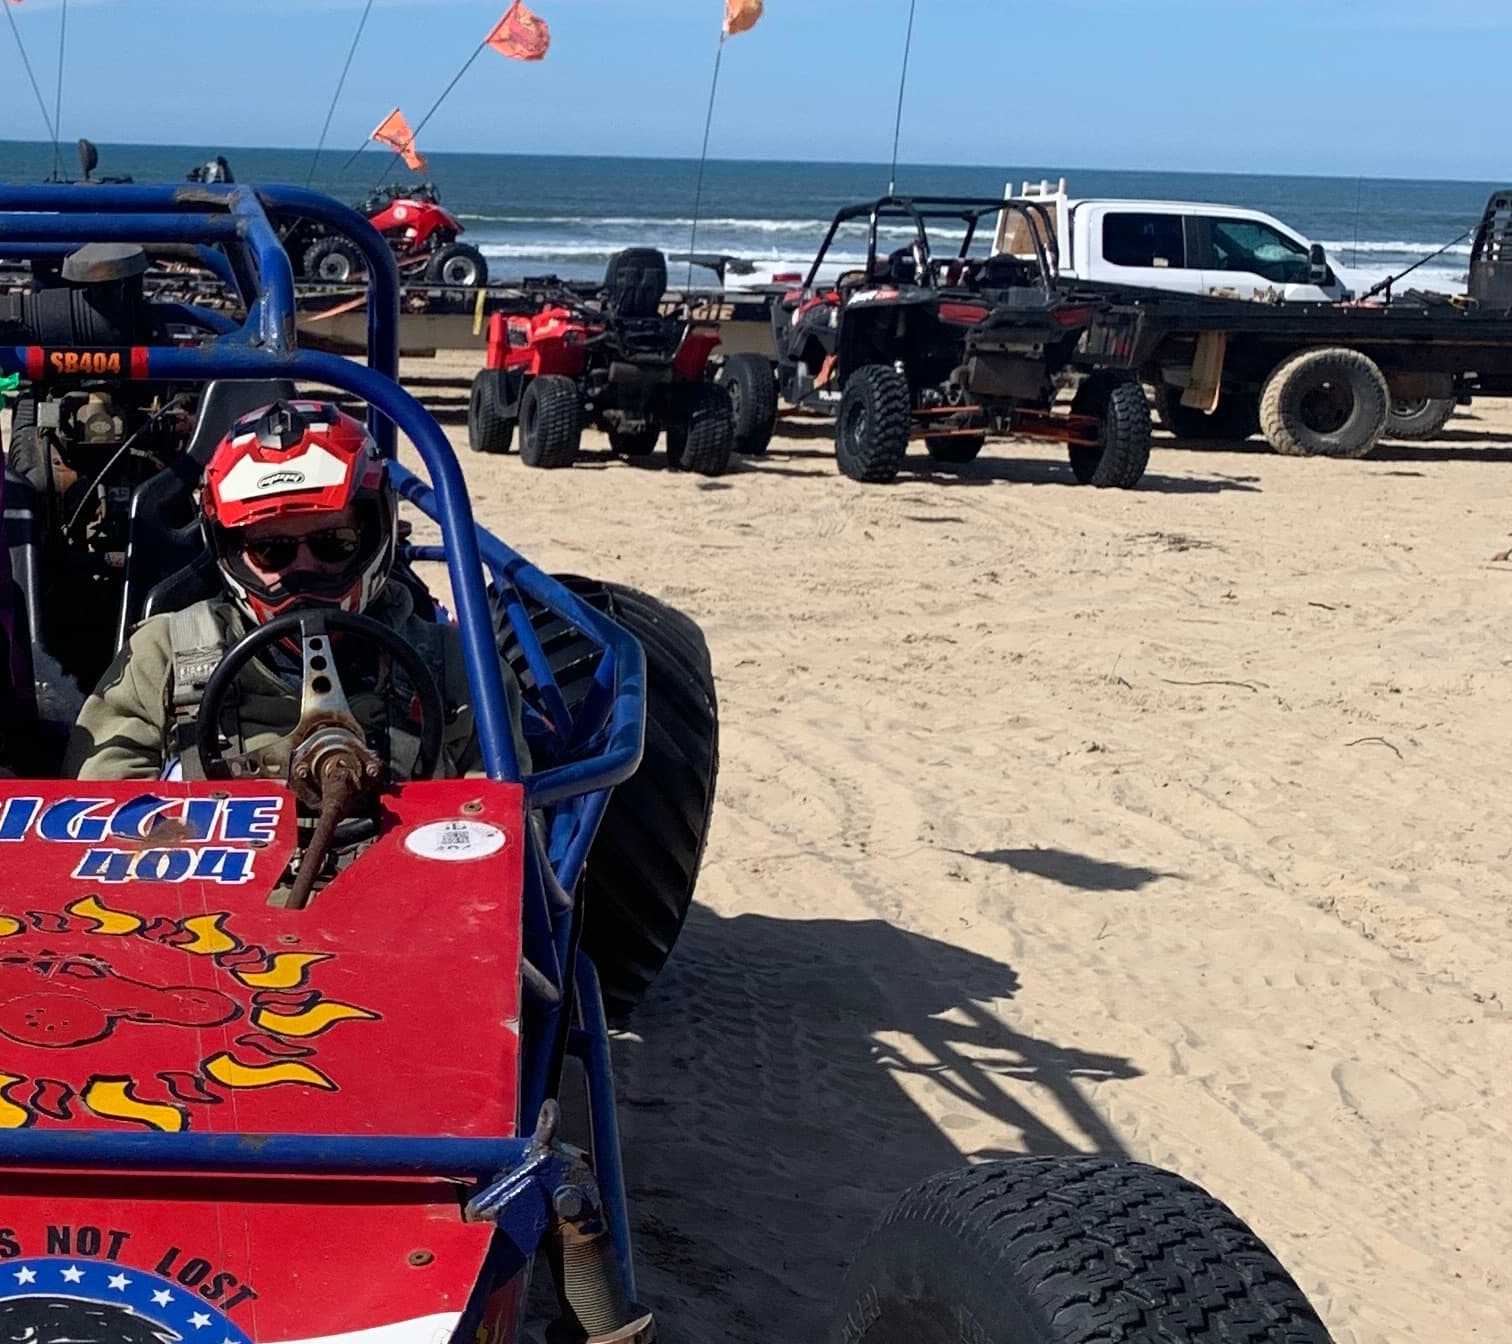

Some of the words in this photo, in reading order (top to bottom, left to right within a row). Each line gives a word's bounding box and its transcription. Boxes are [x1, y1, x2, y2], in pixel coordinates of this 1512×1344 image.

[50, 351, 120, 373] SB404
[71, 847, 256, 884] 404
[46, 1225, 131, 1261] NOT
[154, 1246, 258, 1311] LOST
